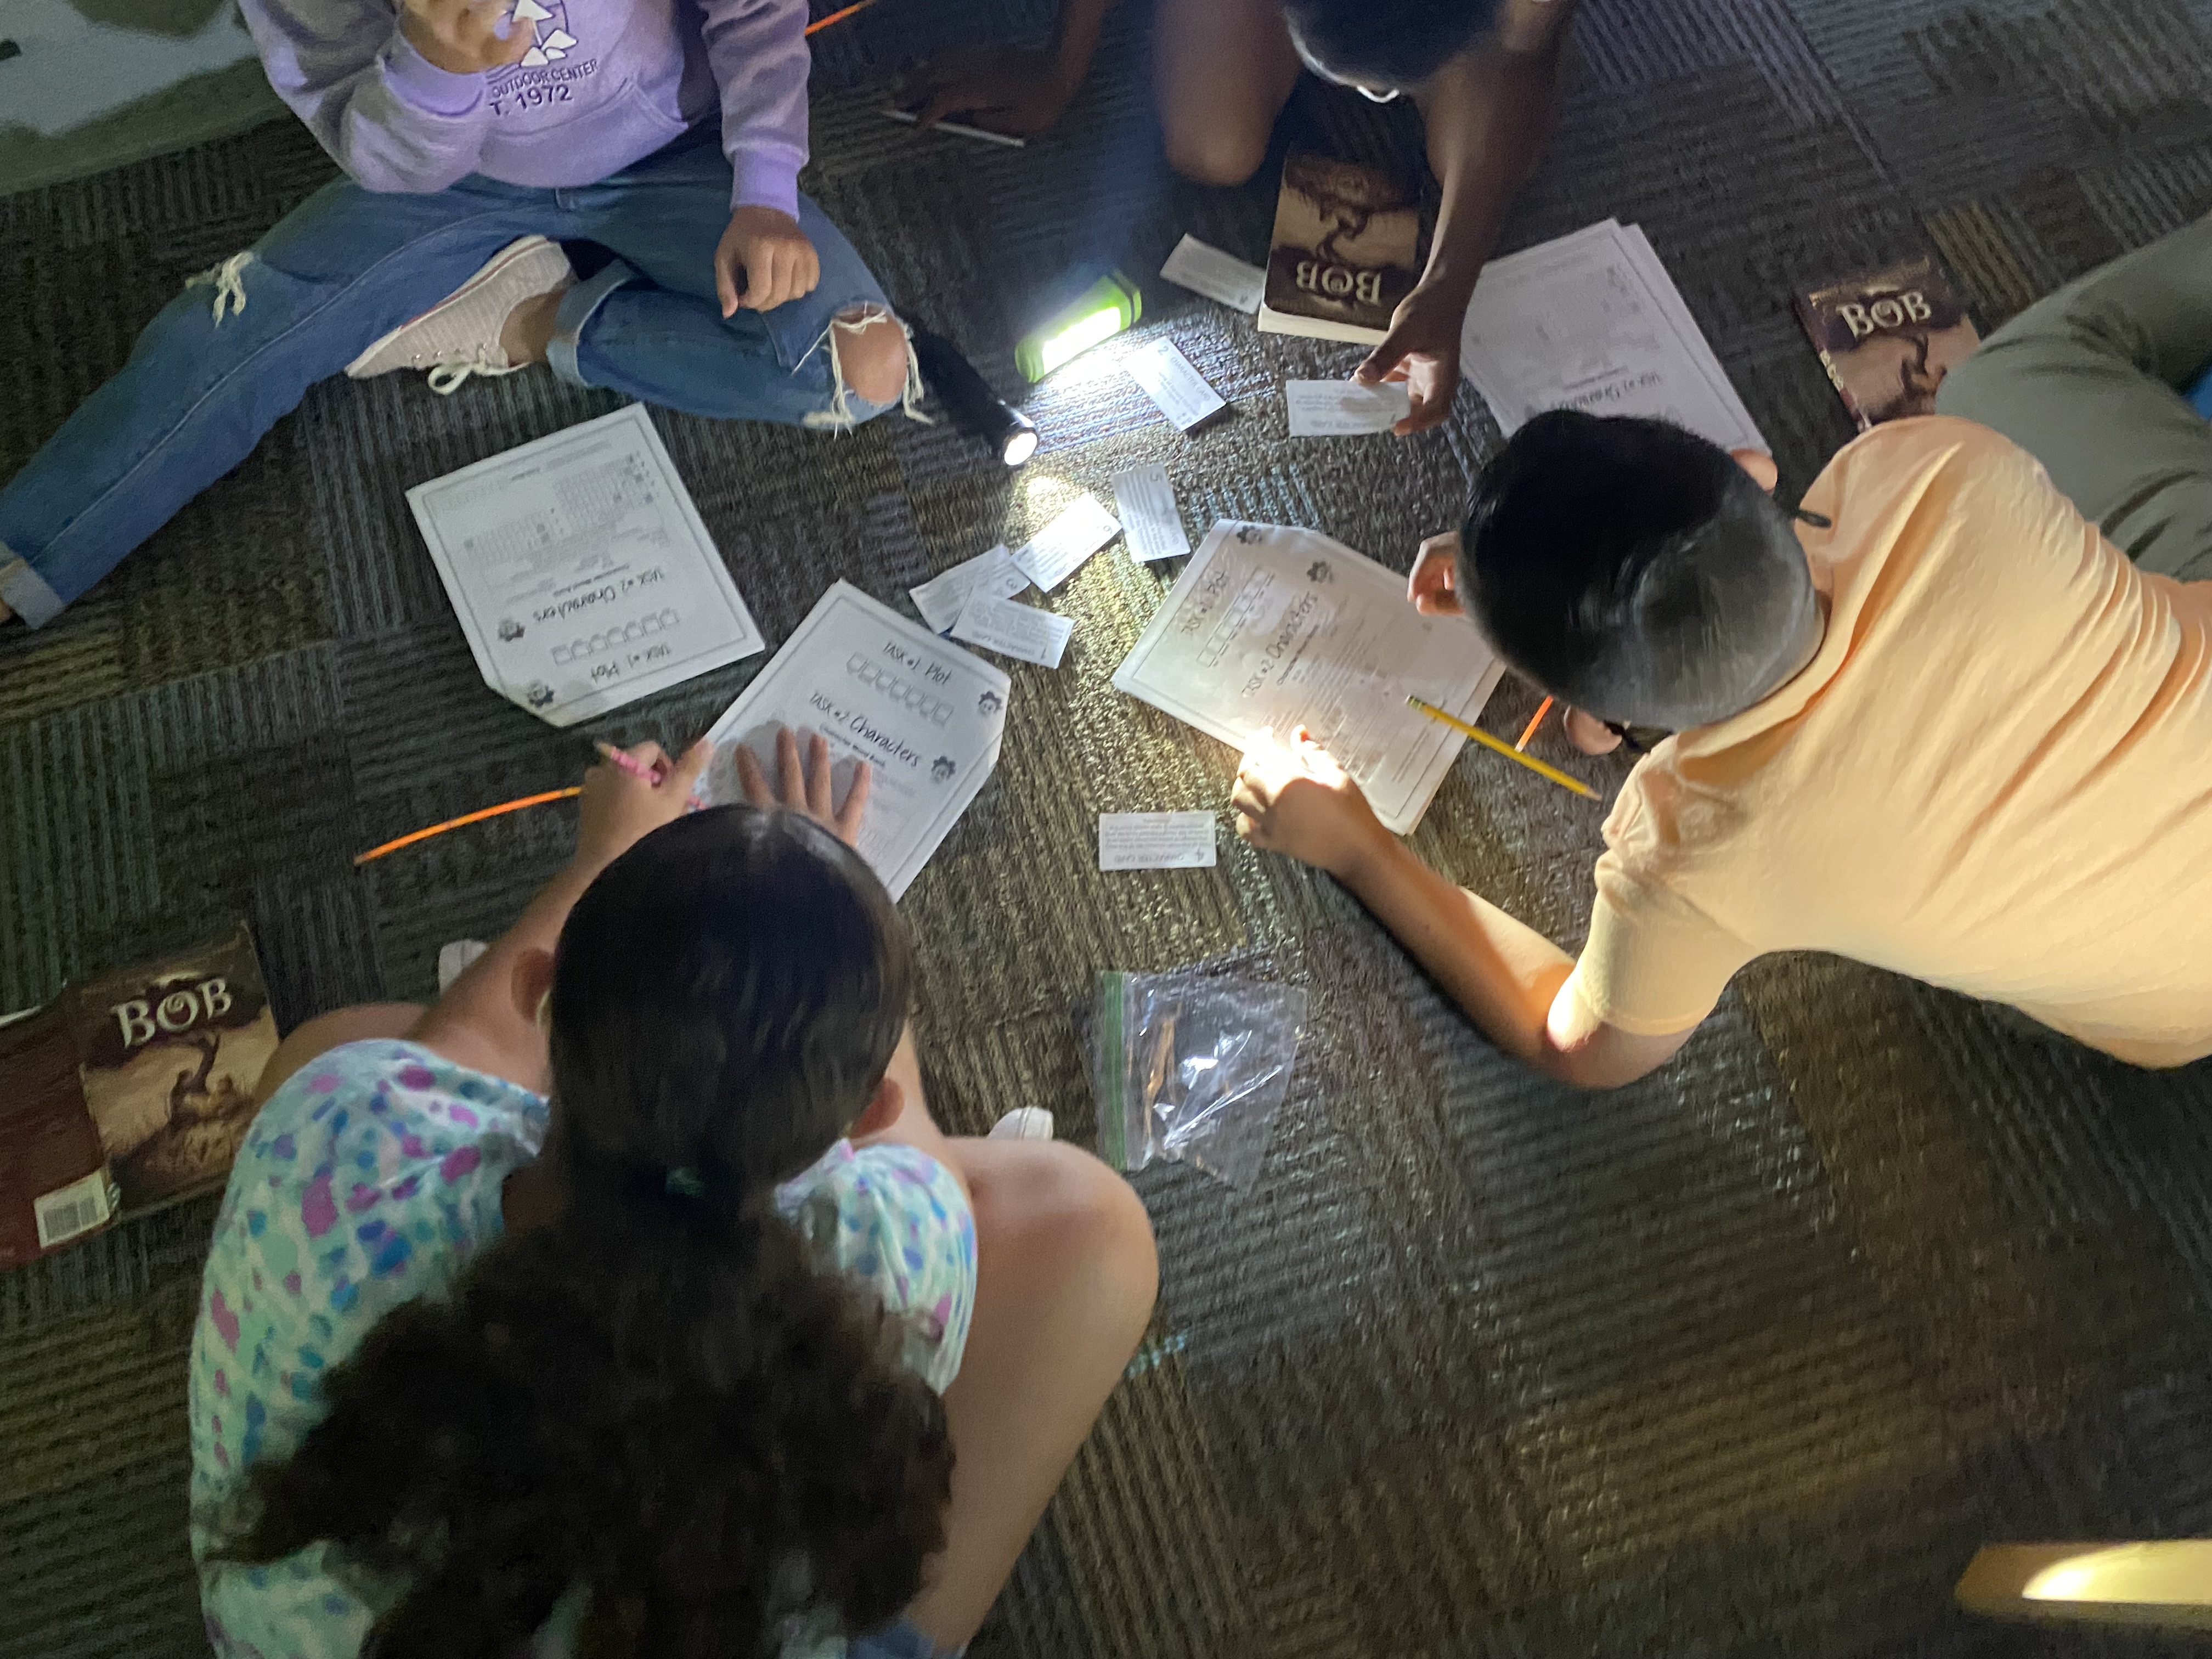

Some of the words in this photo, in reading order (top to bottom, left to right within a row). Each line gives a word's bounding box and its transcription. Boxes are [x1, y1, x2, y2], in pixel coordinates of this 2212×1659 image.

[492, 70, 550, 98] OUTDOOR
[550, 58, 599, 81] CENTER
[515, 83, 573, 109] 1972
[1296, 261, 1383, 308] BOB
[1835, 291, 1932, 340] BOB
[1156, 344, 1170, 356] 2
[1102, 523, 1114, 537] 6
[532, 584, 617, 622] Characters
[1006, 577, 1020, 591] 3
[882, 641, 904, 663] TASK
[924, 659, 953, 686] Plot
[809, 690, 832, 716] TASK
[848, 713, 919, 768] Characters
[110, 978, 232, 1049] BOB
